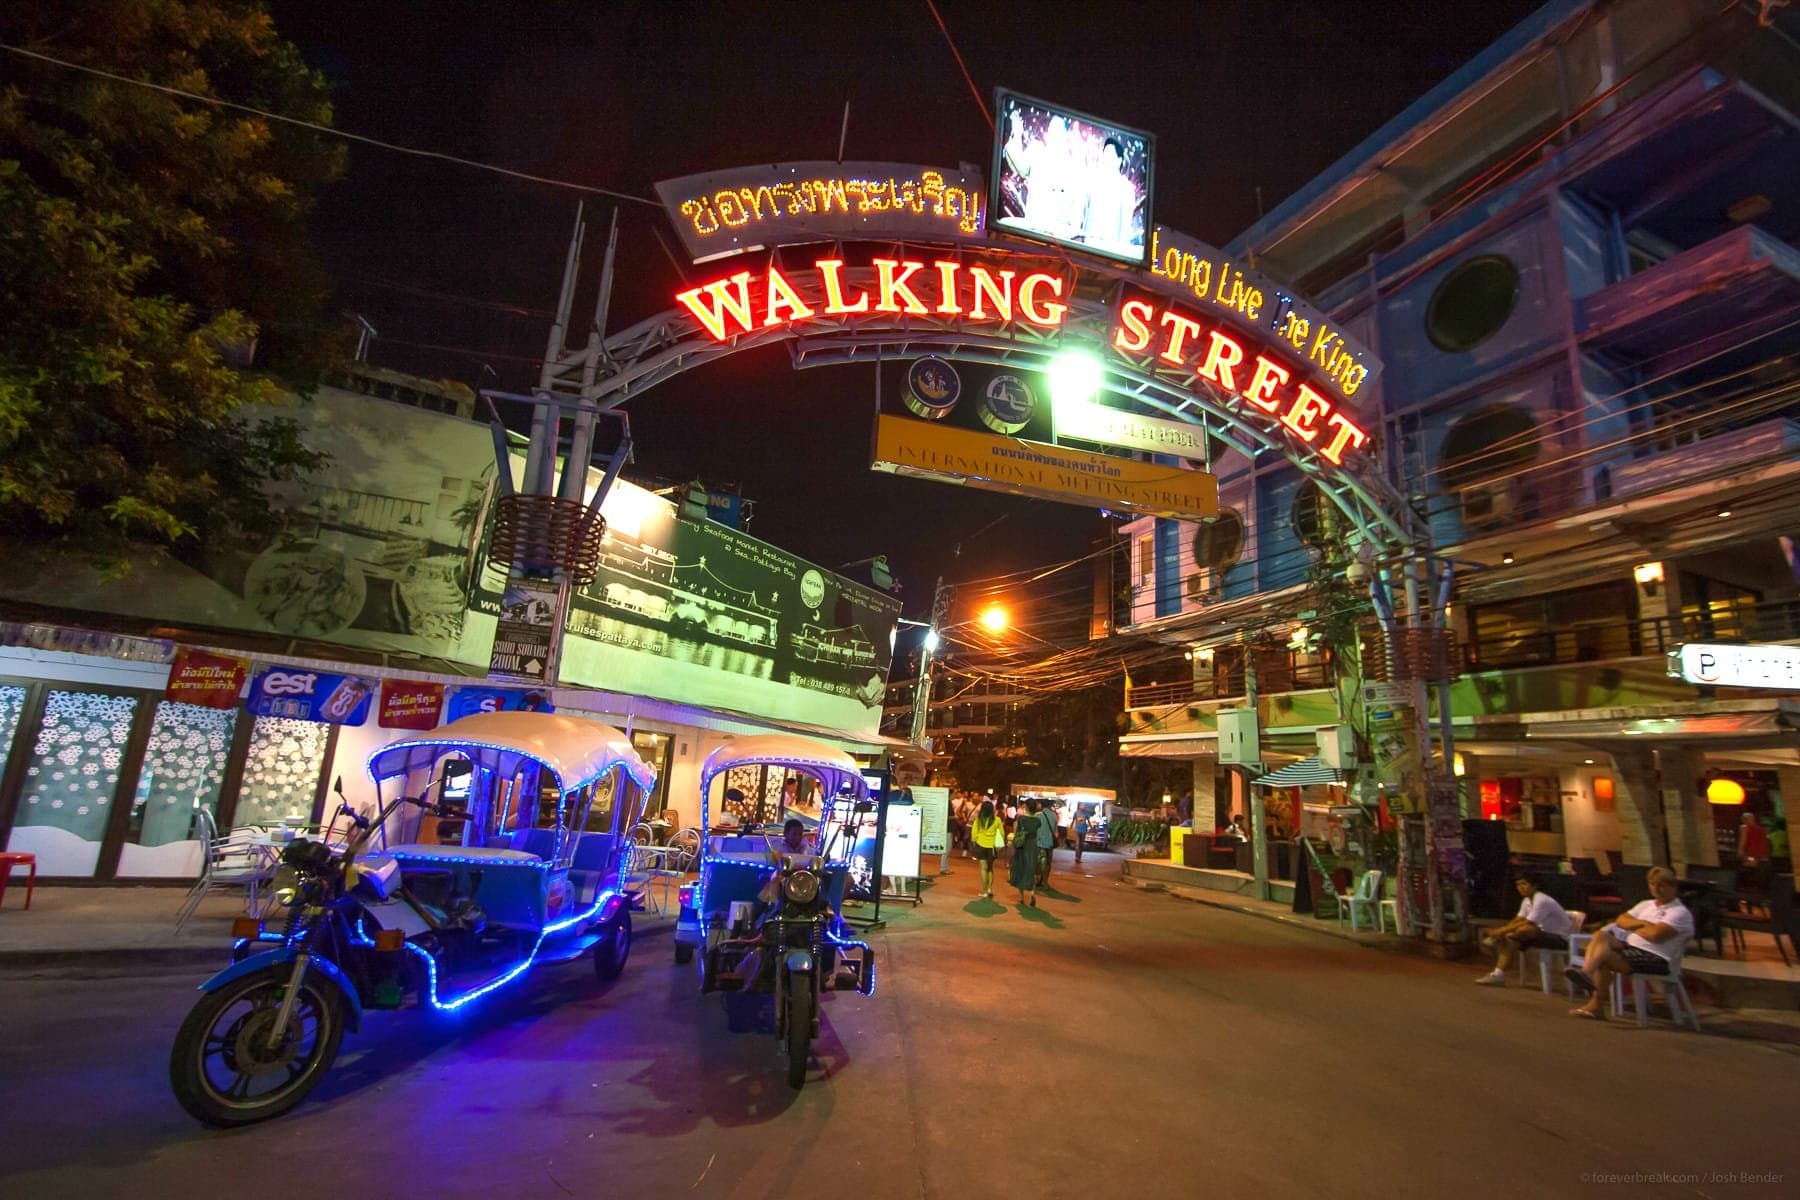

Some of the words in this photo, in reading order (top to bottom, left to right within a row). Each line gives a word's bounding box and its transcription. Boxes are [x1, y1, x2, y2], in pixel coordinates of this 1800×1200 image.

[680, 171, 981, 235] ขอทรงพระเจริญ
[1150, 230, 1212, 297] Long
[1216, 261, 1264, 321] Live
[1309, 323, 1370, 396] King
[675, 257, 1069, 343] WALKING
[1113, 299, 1367, 467] STREET
[898, 445, 1046, 482] INTERNATIONAL
[1055, 473, 1138, 500] MEETING
[1141, 488, 1206, 510] STREET
[703, 525, 735, 543] Seafood
[762, 548, 798, 569] Restaurant
[783, 567, 797, 580] Bay
[516, 643, 548, 659] SQUARE
[564, 622, 661, 653] cruisespattaya.com
[263, 672, 318, 695] est
[331, 685, 358, 717] est
